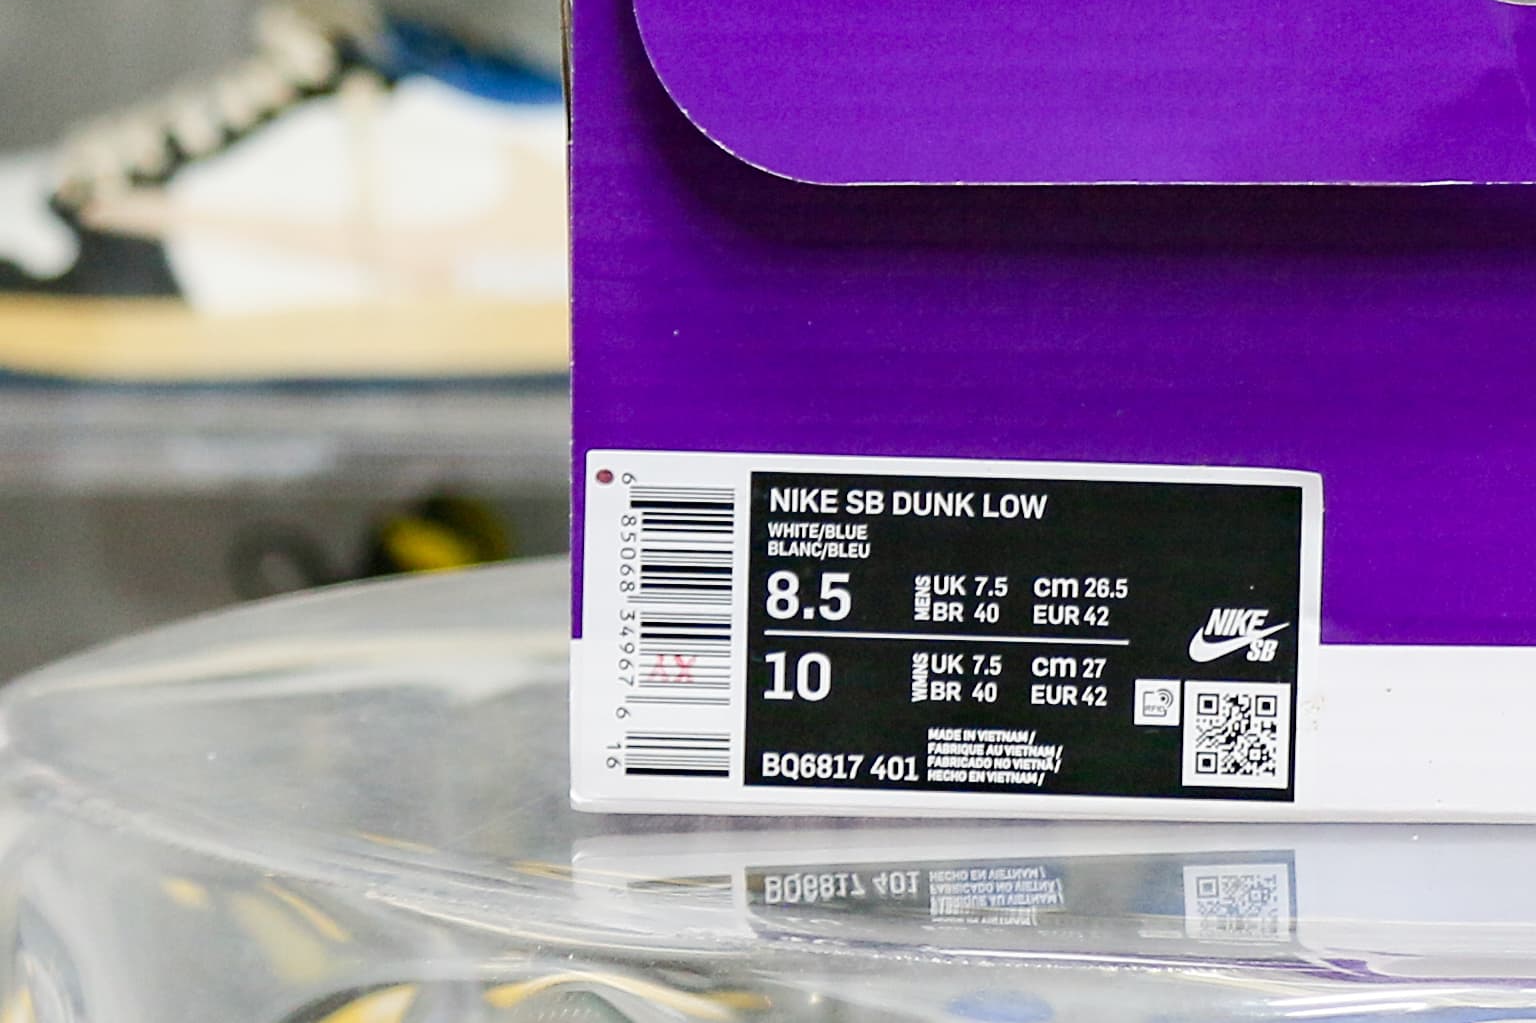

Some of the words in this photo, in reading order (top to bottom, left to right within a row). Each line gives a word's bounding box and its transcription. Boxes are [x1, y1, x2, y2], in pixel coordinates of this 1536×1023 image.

[622, 472, 637, 485] 6
[771, 488, 838, 513] NIKE
[846, 490, 884, 514] SB
[893, 491, 974, 517] DUNK
[983, 494, 1047, 519] LOW
[767, 522, 868, 542] WHITE/BLUE
[620, 515, 637, 592] 85068
[767, 541, 871, 560] BLANC/BLEU
[767, 571, 851, 620] 8.5
[933, 575, 966, 596] UK
[975, 577, 1007, 596] 7.5
[1034, 578, 1078, 598] cm
[1085, 578, 1127, 598] 26.5
[913, 574, 932, 622] MENS
[932, 602, 964, 622] BR
[974, 603, 999, 623] 40
[1034, 605, 1079, 625] EUR
[1084, 606, 1108, 626] 42
[1204, 608, 1269, 636] NIKE
[619, 610, 635, 686] 34967
[1246, 639, 1278, 662] SB
[931, 653, 963, 675] UK
[973, 655, 1001, 675] 7.5
[1032, 657, 1076, 677] cm
[1083, 658, 1106, 678] 27
[764, 652, 831, 701] 10
[911, 652, 928, 703] WMNS
[930, 681, 962, 702] BR
[972, 682, 997, 702] 40
[1031, 685, 1077, 705] EUR
[1082, 686, 1107, 706] 42
[616, 707, 631, 719] 6
[928, 728, 962, 741] MADE
[963, 729, 976, 742] IN
[606, 742, 622, 769] 16
[928, 742, 985, 756] FABRIQUE
[986, 745, 1003, 757] AU
[763, 753, 864, 780] BQ6817
[870, 755, 919, 782] 401
[927, 755, 992, 768] FABRICADO
[994, 757, 1011, 770] NO
[927, 769, 966, 782] HECHO
[968, 771, 985, 784] EN
